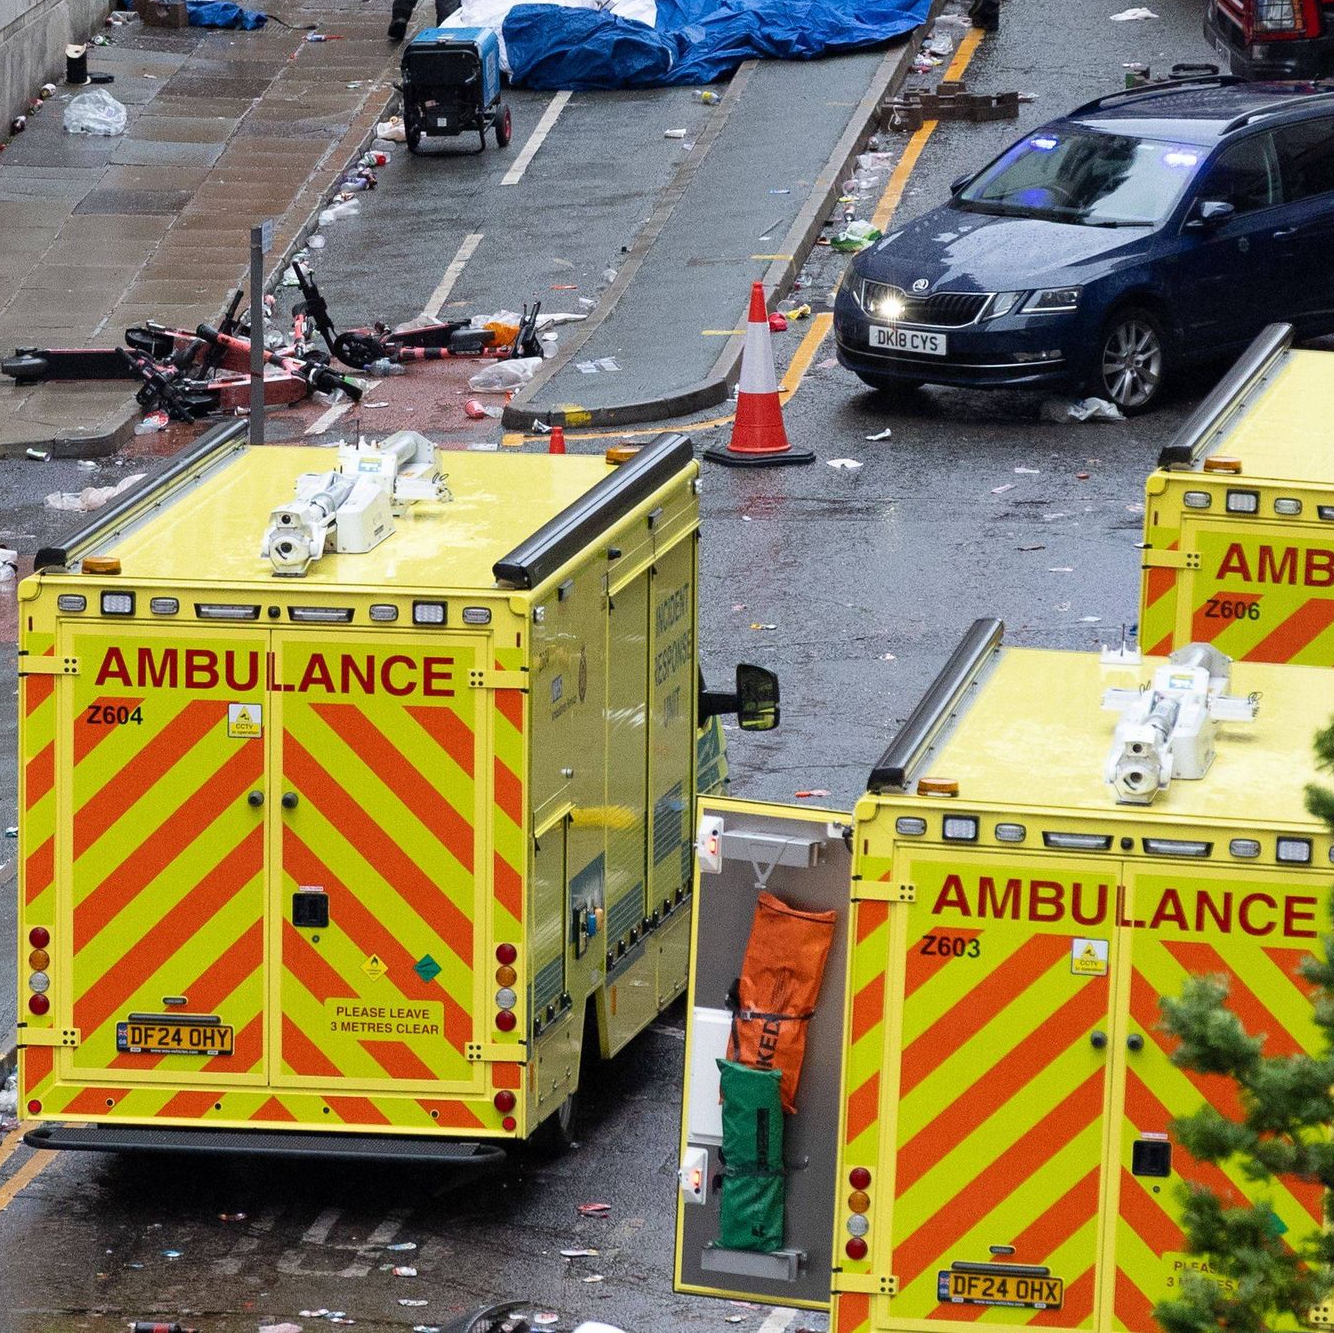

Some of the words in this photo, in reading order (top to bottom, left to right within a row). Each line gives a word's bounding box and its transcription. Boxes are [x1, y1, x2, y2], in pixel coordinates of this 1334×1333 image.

[877, 329, 907, 348] DK18
[911, 334, 938, 352] CYS
[1204, 599, 1261, 621] Z606
[94, 646, 455, 698] AMBULANCE
[86, 705, 144, 726] Z604
[930, 873, 1319, 939] AMBULANCE
[919, 934, 981, 959] Z603
[336, 1006, 386, 1018] PLEASE
[389, 1008, 430, 1019] LEAVE
[131, 1026, 183, 1046] DF24
[189, 1028, 229, 1047] OHY
[330, 1021, 337, 1032] 3
[341, 1022, 393, 1033] METRES
[396, 1023, 439, 1035] CLEAR
[755, 1020, 781, 1069] KED
[953, 1275, 1009, 1298] DF24
[1015, 1280, 1058, 1302] OHX
